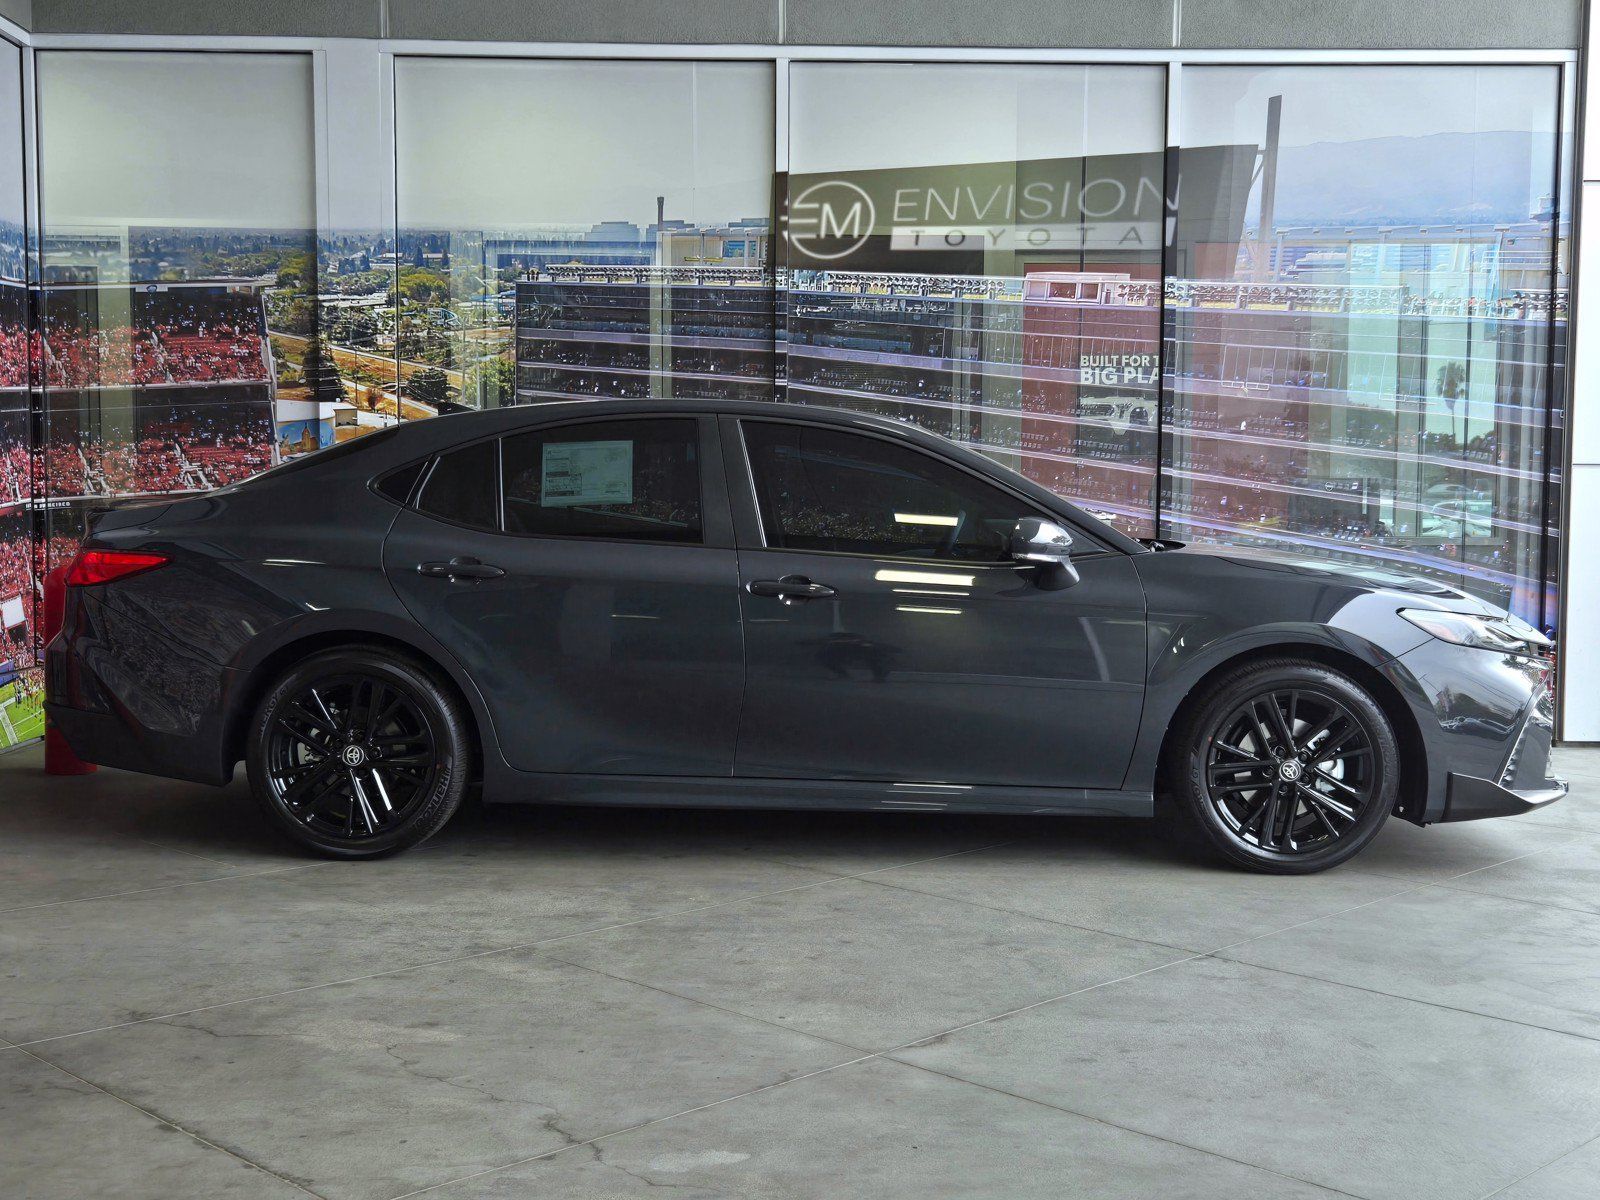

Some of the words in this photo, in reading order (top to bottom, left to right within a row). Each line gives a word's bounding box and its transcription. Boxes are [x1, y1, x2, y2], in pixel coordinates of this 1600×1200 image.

[892, 174, 1182, 223] ENVISION
[910, 226, 1144, 248] TOYOTA
[1080, 355, 1119, 367] BUILT
[1121, 355, 1150, 367] FOR
[1080, 367, 1118, 384] BIG
[1124, 367, 1159, 384] PLA
